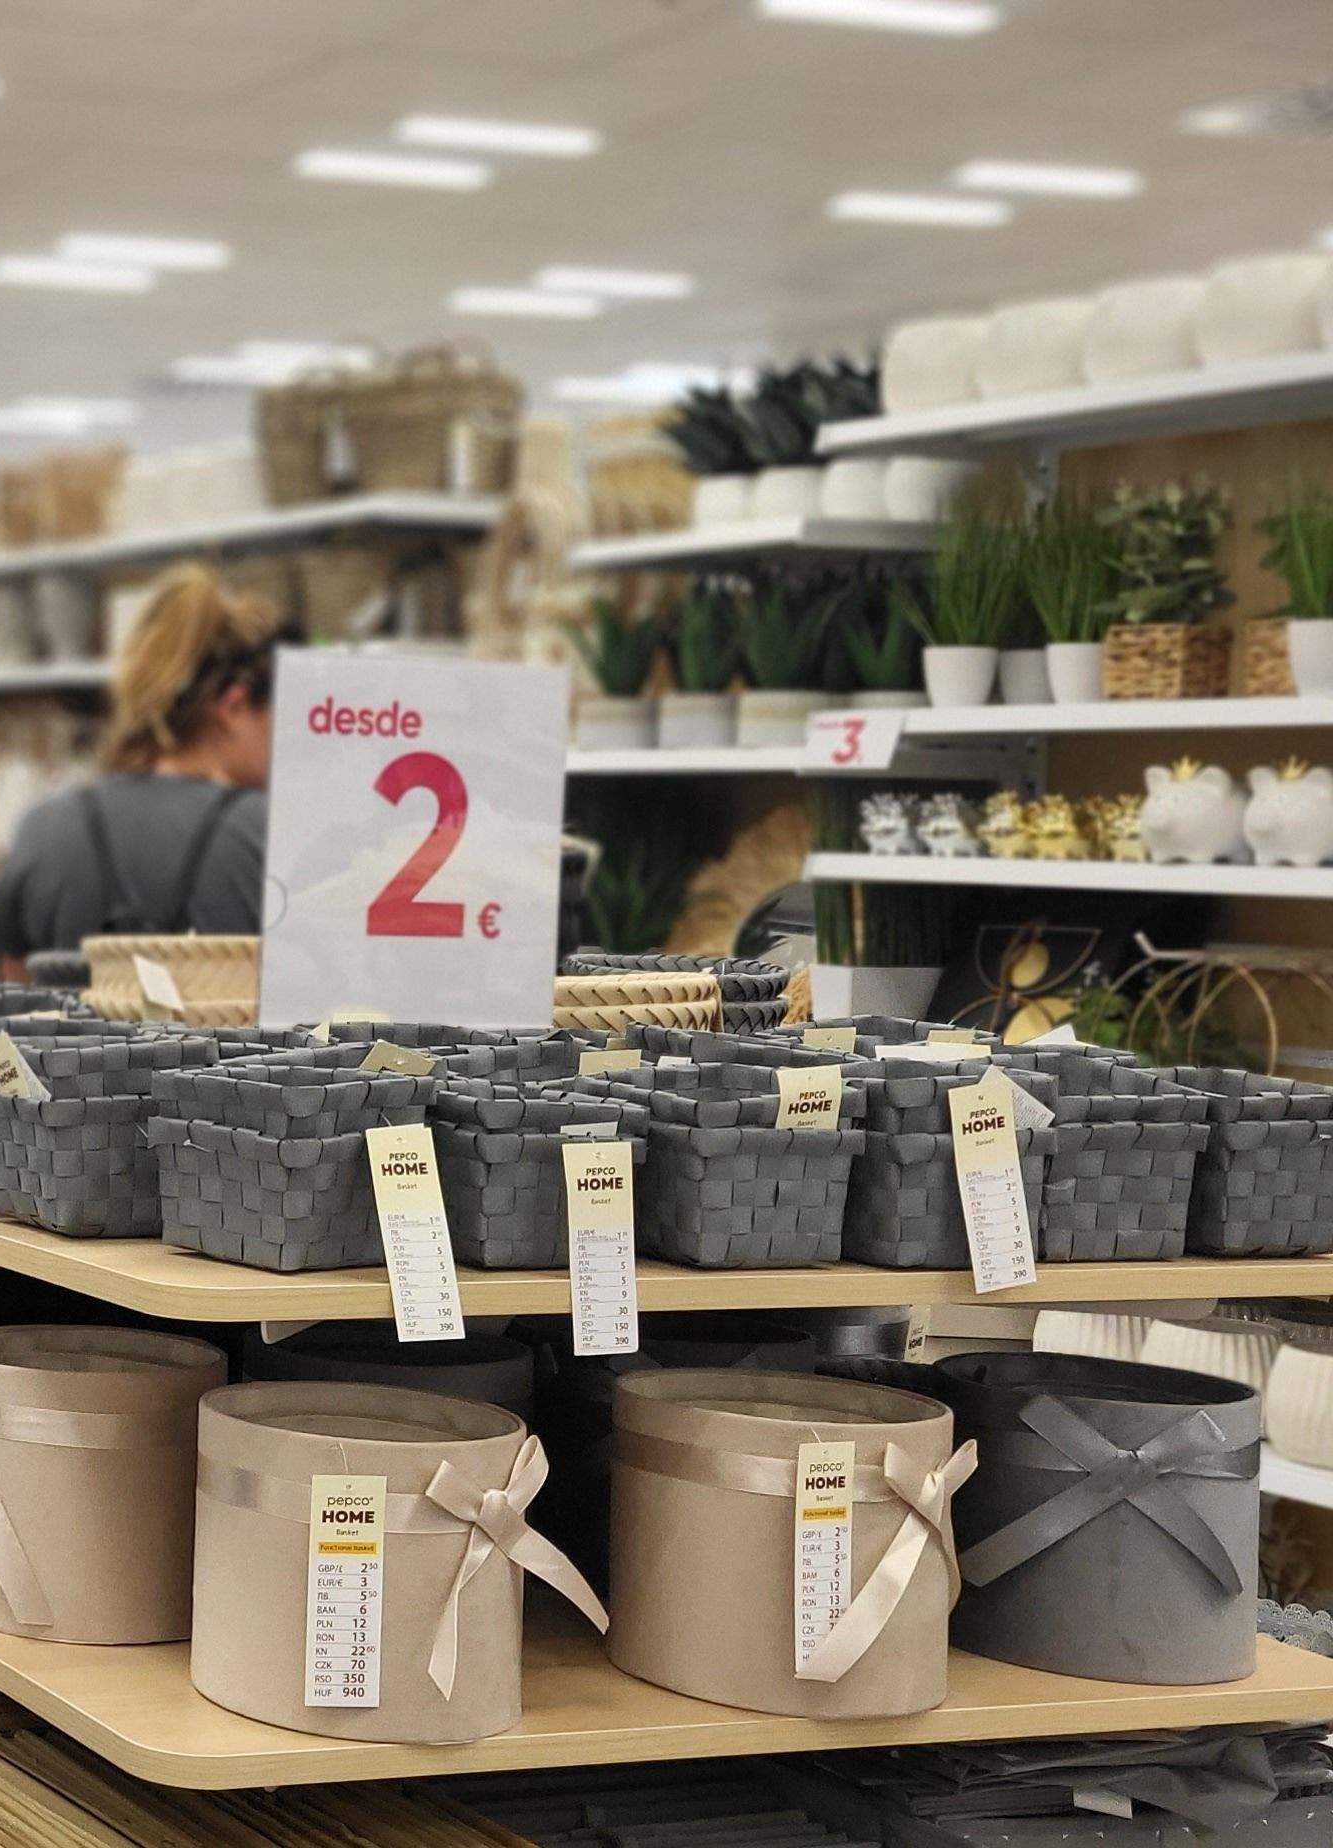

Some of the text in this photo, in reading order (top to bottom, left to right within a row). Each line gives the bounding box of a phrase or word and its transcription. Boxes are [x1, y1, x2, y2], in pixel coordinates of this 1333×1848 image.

[308, 697, 422, 738] desde
[799, 1090, 827, 1100] PEPCO
[787, 1100, 833, 1115] HOME
[970, 1107, 998, 1119] PEPCO
[962, 1116, 1005, 1135] HOME
[389, 1152, 419, 1161] PEPCO
[381, 1162, 429, 1177] HOME
[585, 1166, 616, 1176] PEPCO
[577, 1177, 624, 1191] HOME
[1014, 1240, 1023, 1249] 30
[437, 1247, 443, 1255] 5
[621, 1261, 626, 1269] 5
[1012, 1256, 1025, 1264] 150
[439, 1262, 445, 1270] 5
[1014, 1269, 1027, 1279] 390
[441, 1276, 447, 1284] 9
[621, 1276, 627, 1284] 5
[439, 1292, 450, 1301] 30
[621, 1290, 628, 1298] 9
[437, 1308, 452, 1317] 150
[618, 1306, 628, 1315] 30
[439, 1322, 454, 1331] 390
[614, 1322, 629, 1331] 150
[614, 1336, 629, 1345] 390
[805, 1476, 846, 1490] HOME
[321, 1510, 375, 1523] HOME
[835, 1541, 840, 1551] 3
[834, 1568, 840, 1578] 6
[360, 1577, 367, 1587] 3
[830, 1581, 840, 1592] 12
[829, 1595, 840, 1605] 13
[316, 1604, 367, 1615] BAM 6
[316, 1618, 367, 1628] PLN 12
[316, 1632, 366, 1642] RON 13
[315, 1647, 328, 1655] KN
[314, 1660, 366, 1670] CZK 70
[314, 1673, 365, 1683] RSD 350
[314, 1687, 365, 1697] HUF 940
